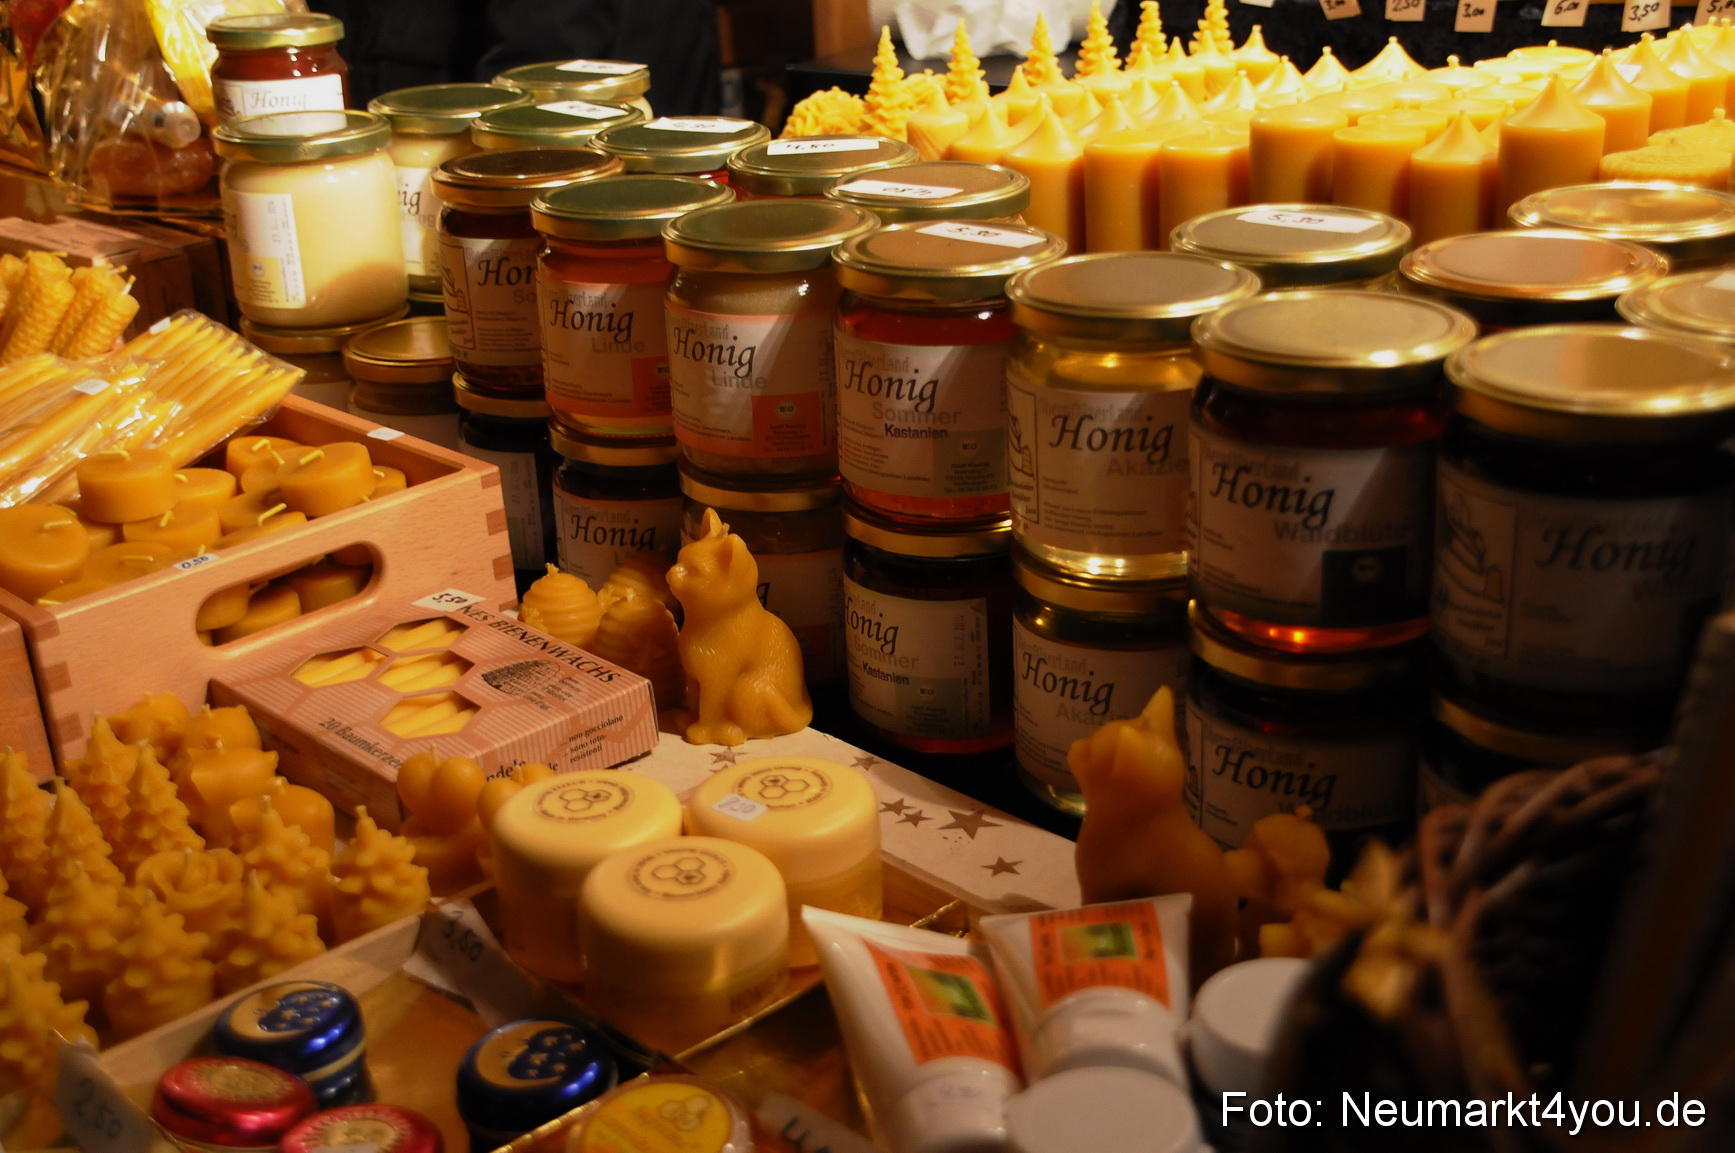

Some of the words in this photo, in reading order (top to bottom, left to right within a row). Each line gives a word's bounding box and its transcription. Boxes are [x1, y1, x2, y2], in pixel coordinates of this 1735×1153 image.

[550, 299, 635, 344] Honig
[591, 336, 647, 354] Linde
[673, 326, 758, 379] Honig
[711, 370, 768, 390] Linde
[844, 360, 940, 413] Honig
[872, 401, 963, 426] Sommer
[884, 423, 949, 440] Kastanien
[1049, 413, 1174, 465] Honig
[1209, 461, 1336, 531] Honig
[570, 514, 657, 552] Honig
[1534, 525, 1700, 587] Honig
[488, 619, 621, 683] BIENENWACHS
[853, 634, 919, 670] Sommer
[862, 660, 910, 686] Kastanien
[1021, 651, 1115, 717] Honig
[584, 713, 624, 739] gocciolano
[1211, 744, 1338, 810] Honig
